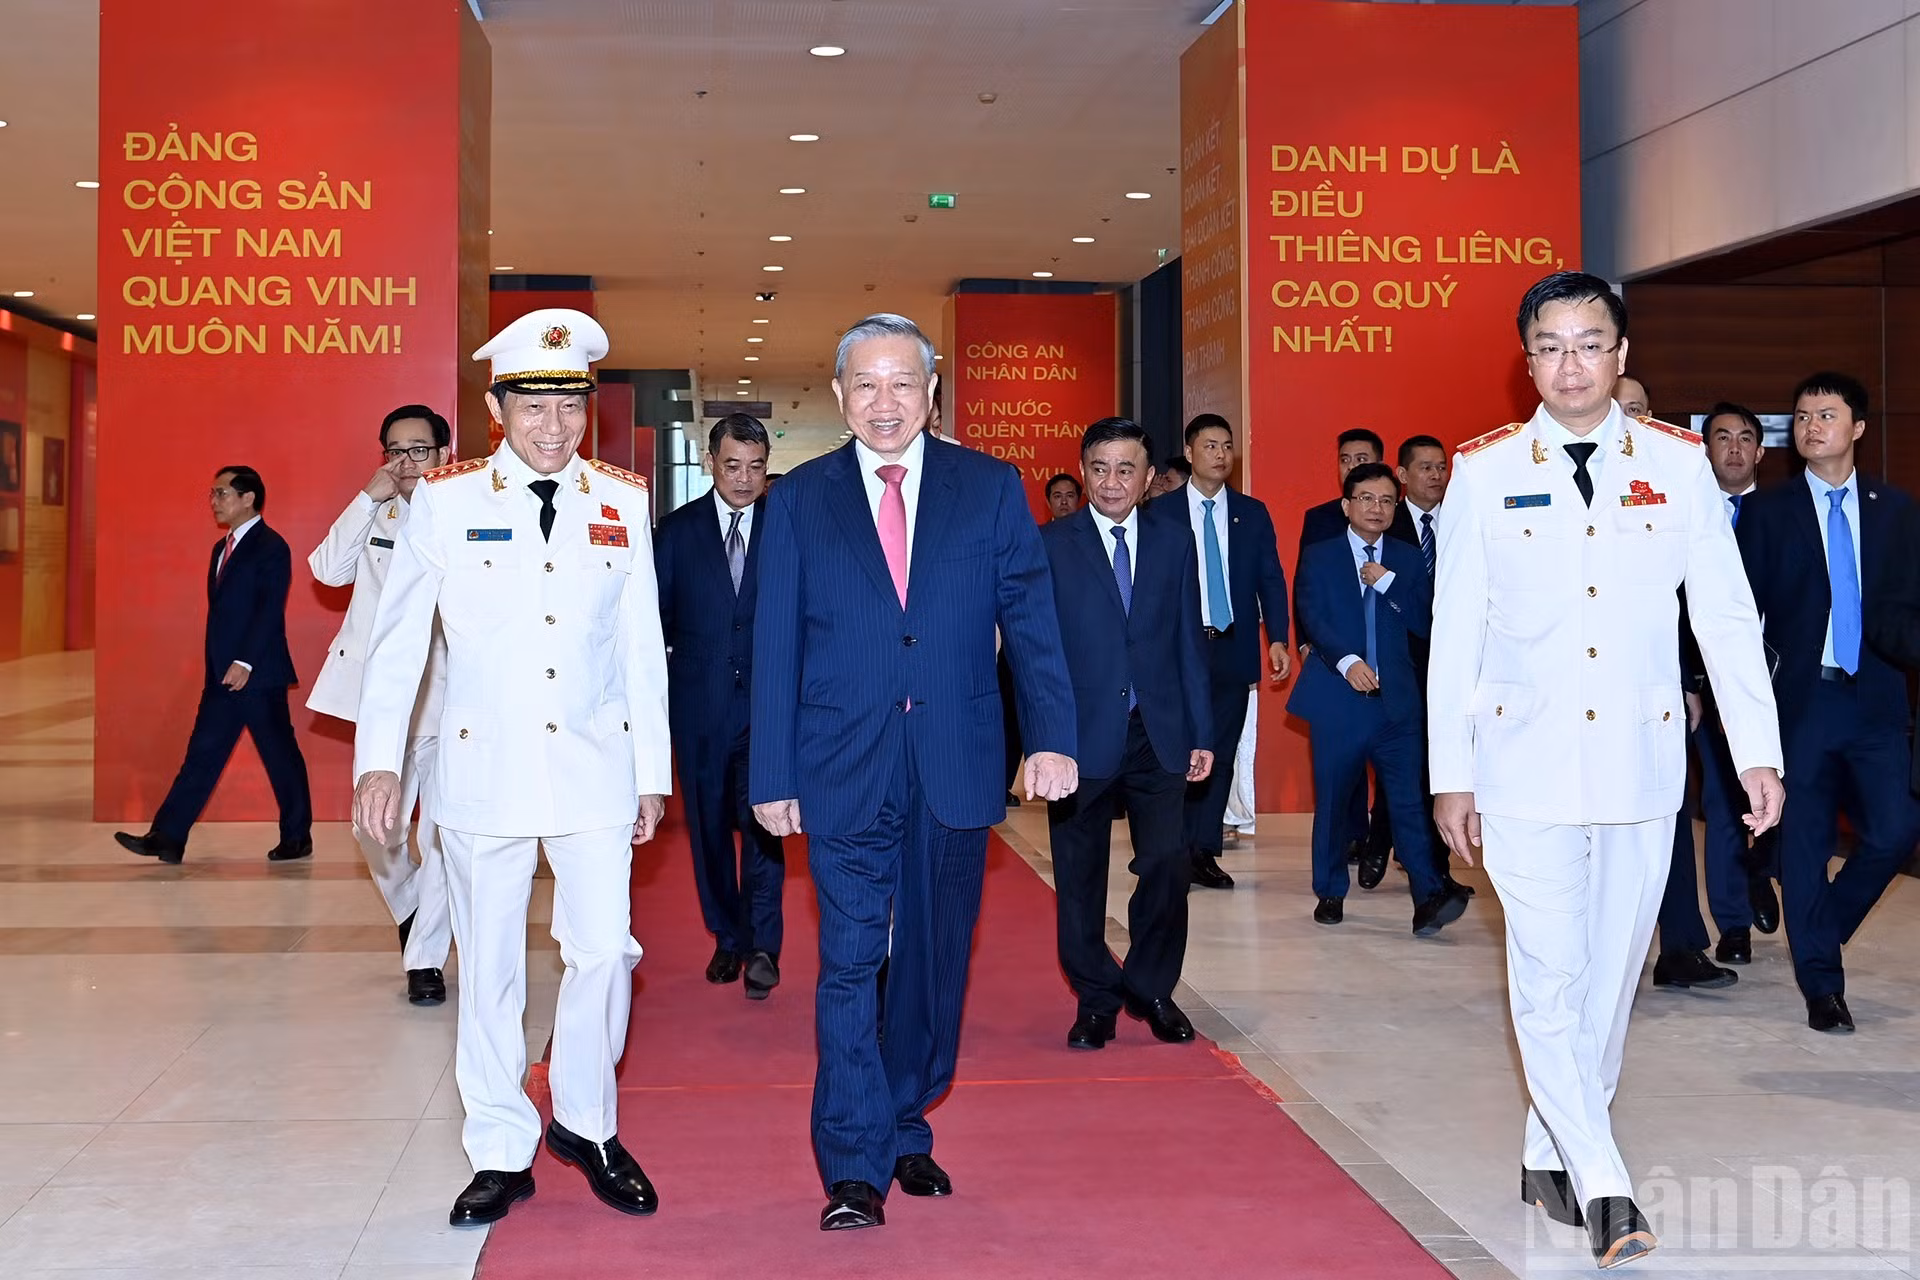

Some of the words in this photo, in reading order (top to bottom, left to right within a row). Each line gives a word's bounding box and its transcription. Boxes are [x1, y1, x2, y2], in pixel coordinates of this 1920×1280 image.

[123, 122, 258, 162] ĐẢNG
[1271, 145, 1387, 173] DANH
[1402, 144, 1460, 181] DỰ
[1472, 140, 1521, 175] LÀ
[123, 172, 262, 217] CỘNG
[278, 171, 372, 210] SẢN
[1270, 180, 1364, 218] ĐIỀU
[122, 220, 221, 265] VIỆT
[236, 228, 341, 257] NAM
[1270, 229, 1421, 264] THIÊNG
[1436, 230, 1564, 271] LIÊNG,
[122, 276, 292, 309] QUANG
[306, 276, 417, 306] VINH
[1271, 280, 1360, 308] CAO
[1372, 274, 1458, 311] QUÝ
[123, 317, 266, 354] MUÔN
[284, 317, 402, 354] NĂM!
[966, 341, 1028, 359] CÔNG
[1034, 345, 1064, 359] AN
[1273, 315, 1392, 353] NHẤT!
[966, 363, 1026, 380] NHÂN
[1033, 363, 1077, 381] DÂN
[966, 398, 985, 416] VÌ
[992, 398, 1052, 416] NƯỚC
[966, 420, 1025, 439] QUÊN
[1031, 421, 1087, 438] THÂN
[991, 442, 1035, 459] DÂN
